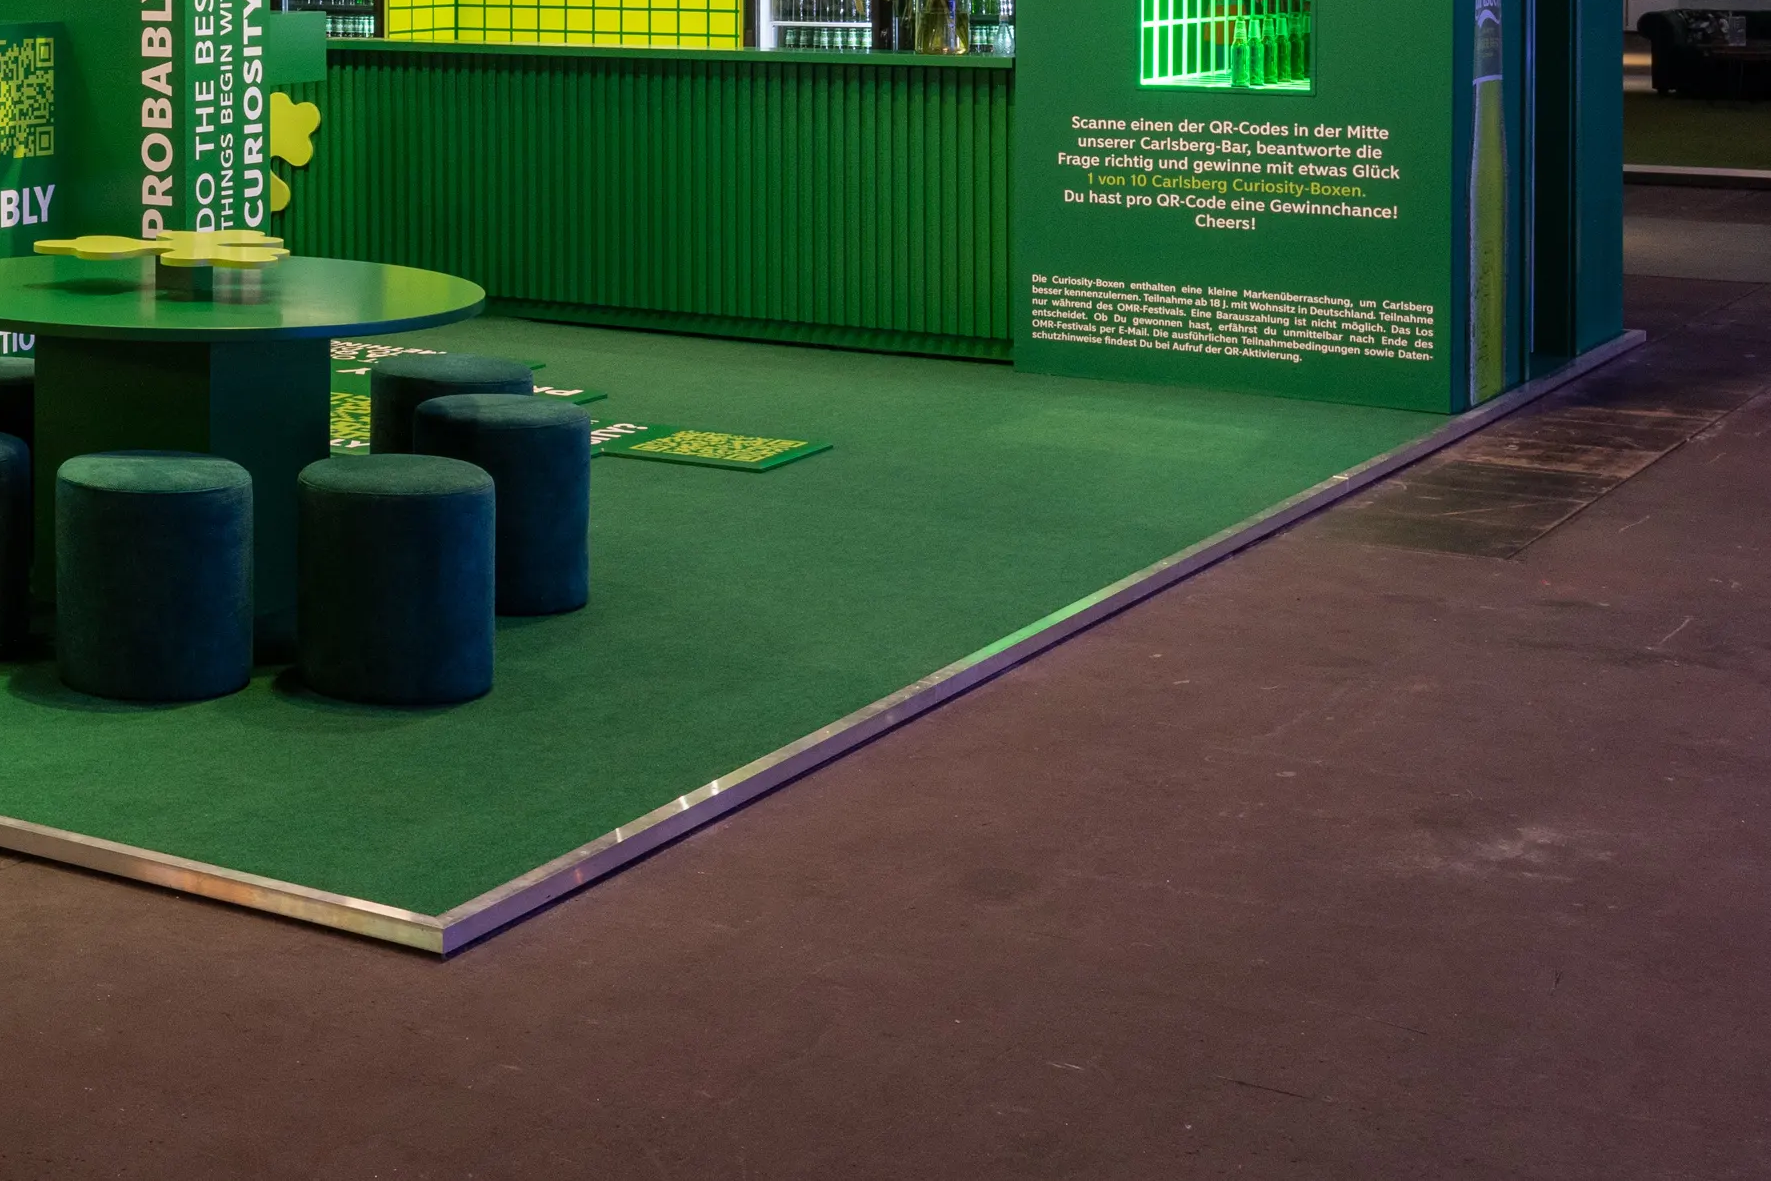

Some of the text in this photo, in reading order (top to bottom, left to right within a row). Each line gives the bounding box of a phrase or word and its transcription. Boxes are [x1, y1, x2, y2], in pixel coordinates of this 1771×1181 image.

[220, 44, 234, 124] BEGIN
[195, 80, 215, 160] THE
[1071, 116, 1390, 139] Scanne einen der QR-Codes in der Mitte
[1058, 152, 1400, 179] Frage richtig und gewinne mit etwas Glück
[1077, 138, 1383, 159] unserer Carlsberg-Bar, beantworte die
[221, 132, 234, 231] THINGS
[1086, 174, 1366, 197] 1 von 10 Carlsberg Curiosity-Boxen.
[195, 172, 215, 233] DO
[1064, 190, 1398, 218] Du hast pro QR-Code eine Gewinnchance!
[1194, 214, 1256, 230] Cheers!
[1031, 274, 1434, 314] Die Curiosity-Boxen enthalten eine kleine Markenüberraschung, um Carlsberg
[1031, 285, 1434, 324] besser kennenzulernen. Teilnahme ab 18 J. mit Wohnsitz in Deutschland. Teilnahme
[1031, 299, 1434, 336] nur während des OMR-Festivals. Eine Barauszahlung ist nicht möglich. Das Los
[1031, 309, 1434, 348] entscheidet. Ob Du gewonnen hast, erfährst du unmittelbar nach Ende des
[1031, 320, 1433, 361] OMR-Festivals per E-Mail. Die ausführlichen Teilnahmebedingungen sowie Daten-
[1031, 331, 1303, 362] schutzhinweise findest Du bei Aufruf der QR-Aktivierung.
